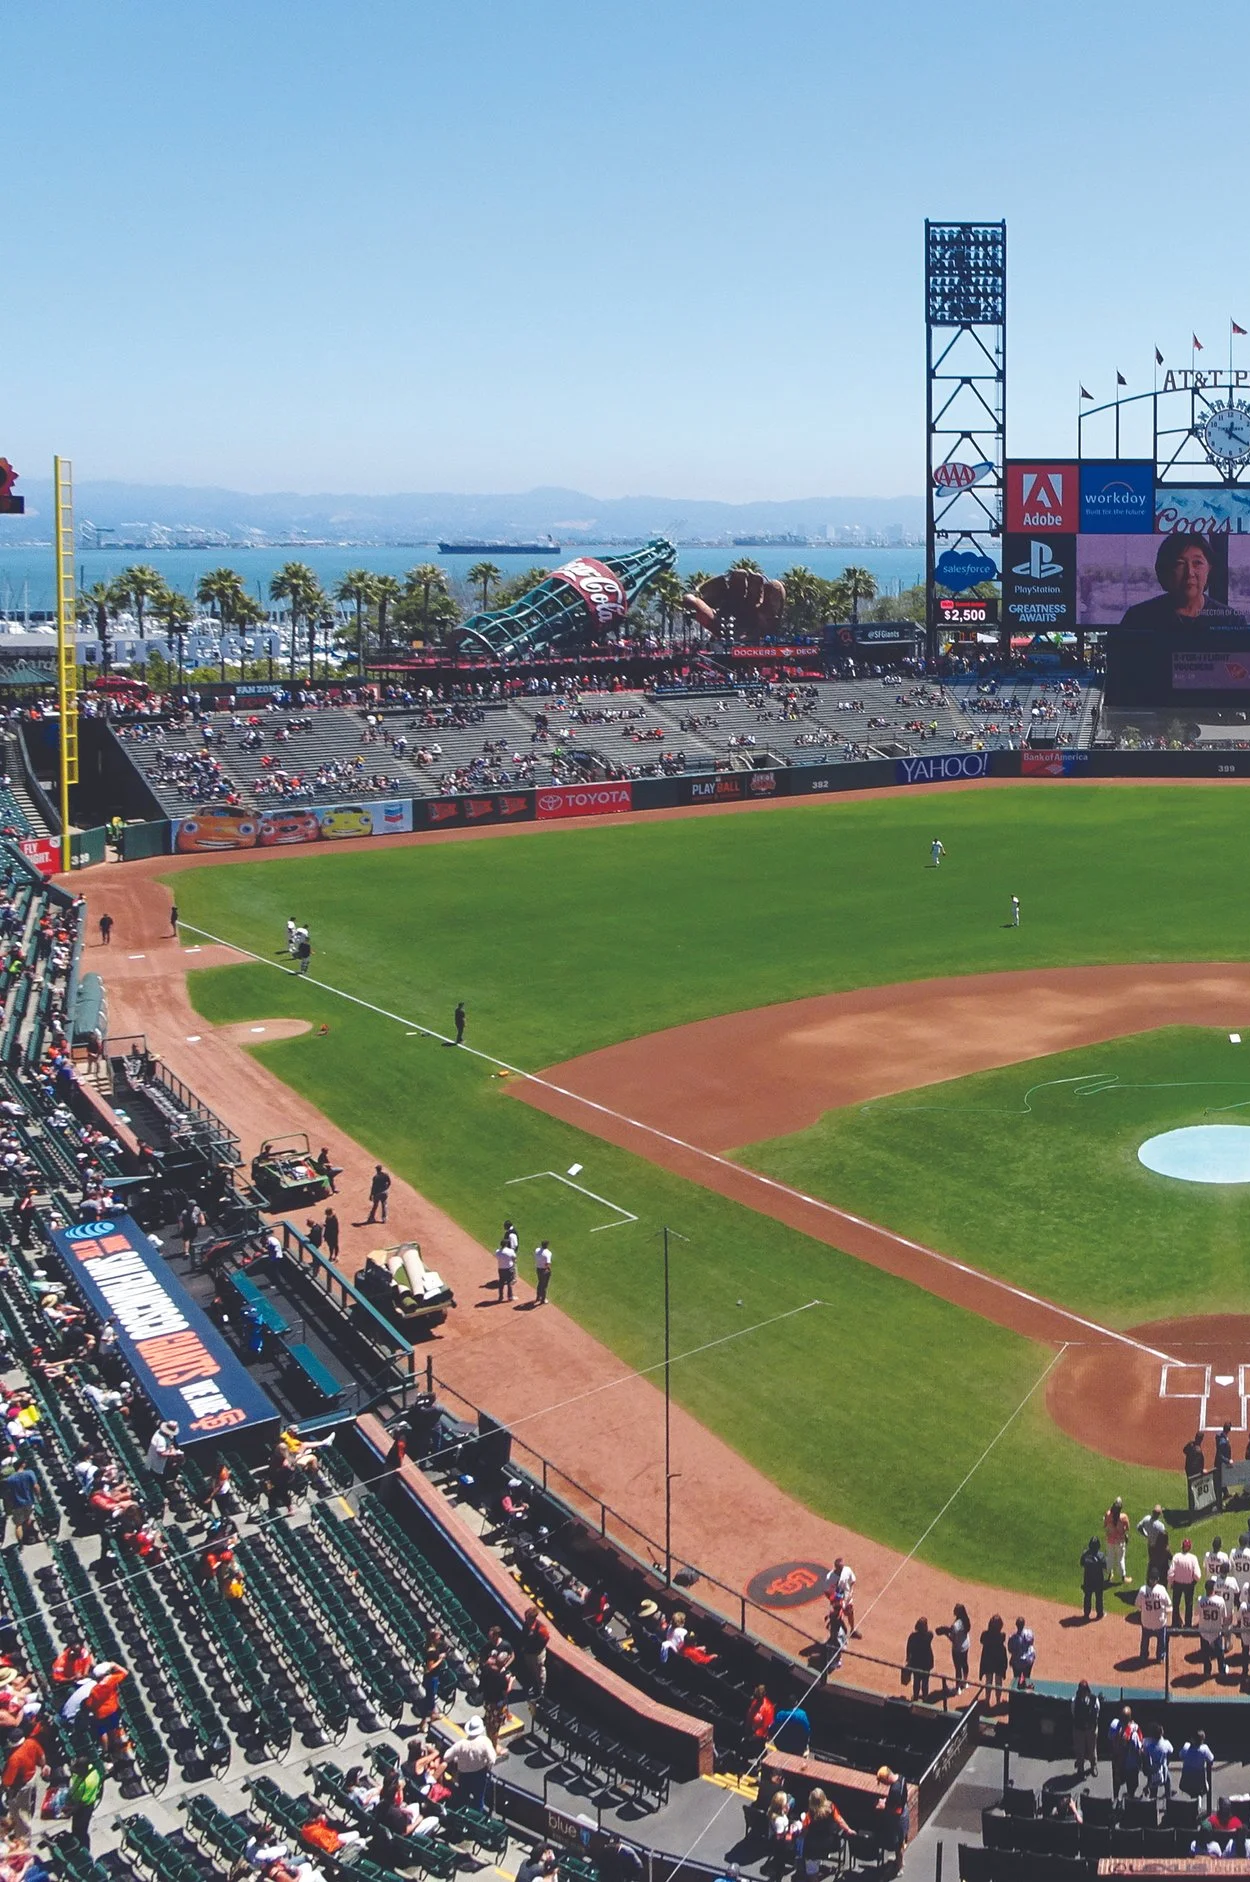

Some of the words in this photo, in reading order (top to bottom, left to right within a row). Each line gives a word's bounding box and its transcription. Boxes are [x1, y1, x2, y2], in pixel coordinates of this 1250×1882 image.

[1163, 370, 1223, 391] AT&T
[936, 464, 974, 488] AAA
[1085, 492, 1146, 506] workday
[1125, 508, 1145, 516] future
[1023, 513, 1062, 526] Adobe
[1155, 508, 1233, 534] Coors
[943, 564, 991, 575] salesforce
[1014, 585, 1061, 595] PlayStation
[944, 609, 986, 622] $2,500
[1008, 604, 1067, 614] GREATNESS
[1018, 613, 1057, 622] AWAITS
[868, 630, 901, 639] @SFGiants
[796, 648, 818, 656] DECK
[235, 686, 256, 694] FAN
[1023, 753, 1045, 761] Bank
[1045, 753, 1055, 761] of
[1054, 752, 1089, 761] America
[902, 753, 989, 783] YAHOO!
[1217, 764, 1236, 773] 399
[692, 782, 716, 796] PLAY
[716, 780, 741, 793] BALL
[811, 780, 829, 790] 382
[566, 790, 630, 808] TOYOTA
[23, 842, 38, 855] FLY
[71, 852, 90, 866] 339
[83, 1251, 148, 1281] SAN
[96, 1271, 190, 1340] FRANCISCO
[135, 1331, 221, 1386] GIANTS
[1235, 1562, 1250, 1574] 50
[1145, 1601, 1161, 1612] 50
[1202, 1609, 1219, 1621] 50
[548, 1811, 577, 1838] blue
